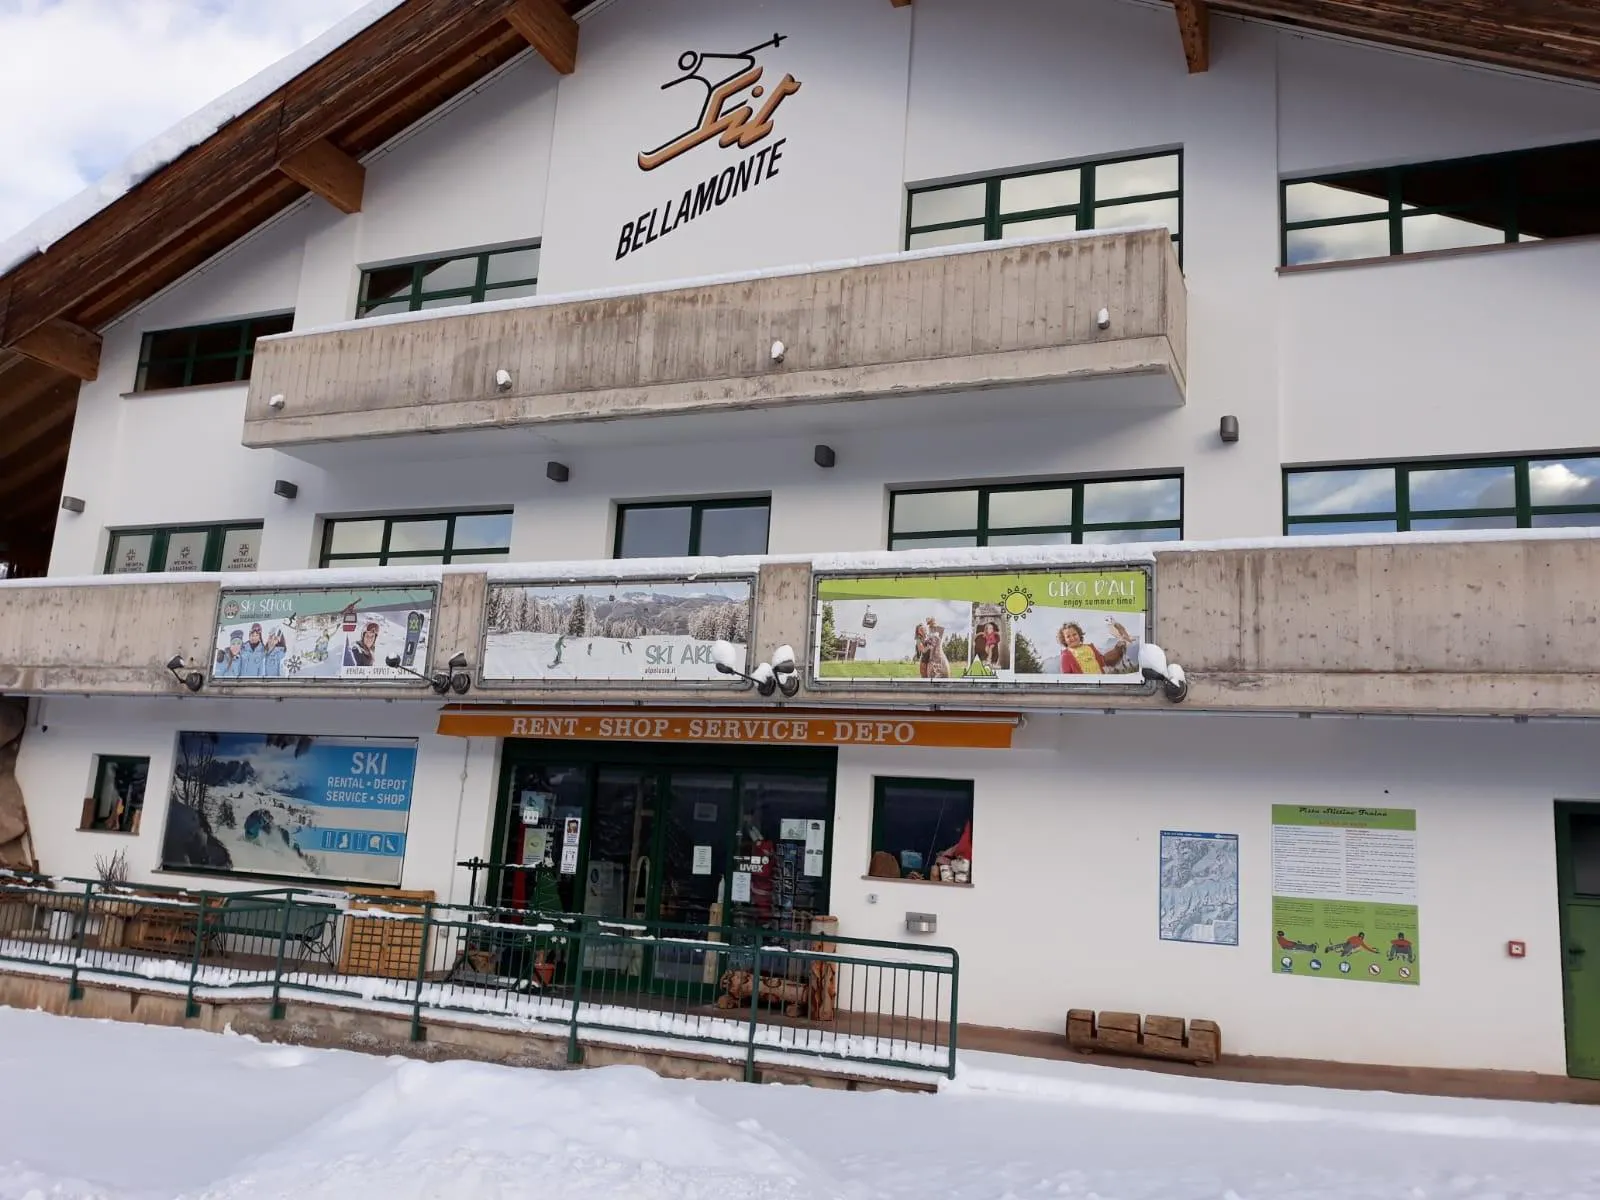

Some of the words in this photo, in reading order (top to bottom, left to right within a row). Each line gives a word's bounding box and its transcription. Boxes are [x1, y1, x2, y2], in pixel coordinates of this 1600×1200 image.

[615, 138, 786, 261] BELLAMONTE
[240, 599, 256, 612] SKI
[260, 599, 292, 612] SCHOOL
[1063, 599, 1082, 607] enjoy
[1116, 597, 1136, 605] time!
[645, 644, 674, 664] SKI
[681, 644, 713, 664] ARE
[511, 717, 579, 736] RENT
[598, 718, 669, 737] SHOP
[688, 719, 809, 740] SERVICE
[833, 721, 915, 742] DEPO
[351, 751, 388, 775] SKI
[327, 776, 365, 788] RENTAL
[374, 778, 408, 790] DEPOT
[326, 790, 368, 803] SERVICE
[376, 793, 405, 805] SHOP
[740, 864, 763, 872] uvex
